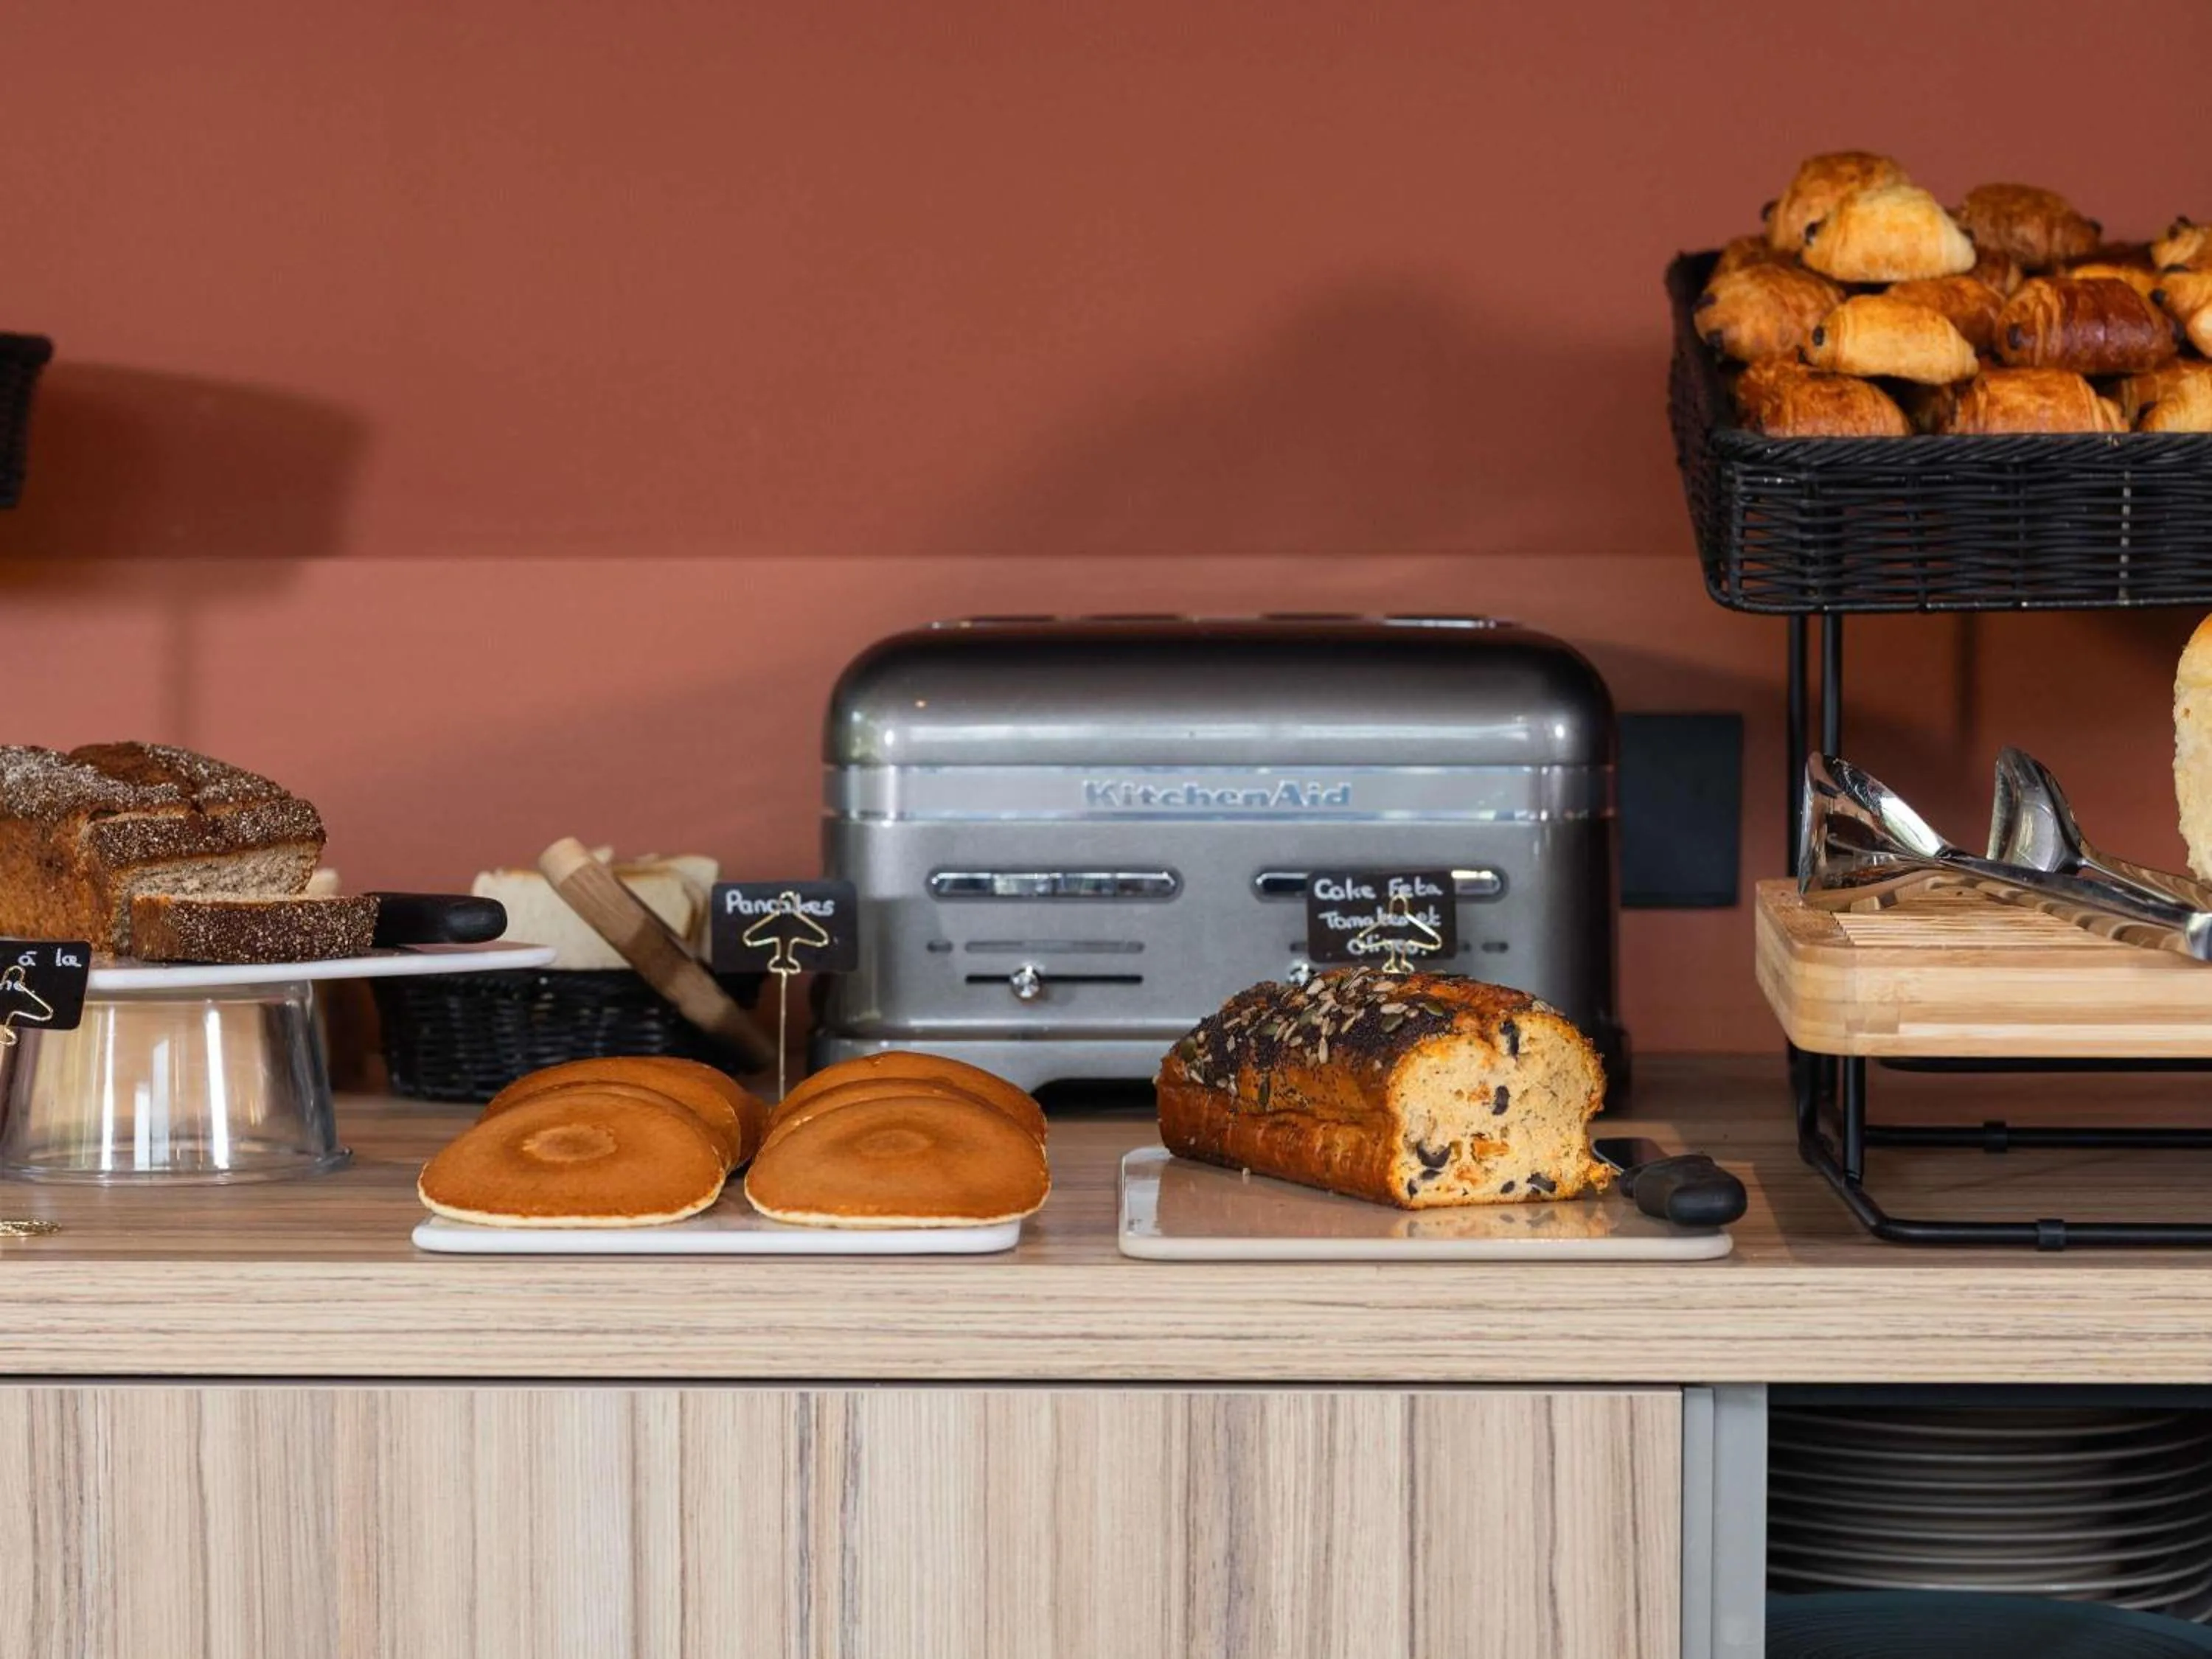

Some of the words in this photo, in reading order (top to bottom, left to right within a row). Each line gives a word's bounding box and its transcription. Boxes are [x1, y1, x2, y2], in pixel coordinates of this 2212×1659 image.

[1082, 779, 1352, 808] KitchenAid
[1313, 877, 1377, 900] Cake
[1388, 875, 1443, 899] Feta
[725, 889, 835, 916] Pancakes
[55, 947, 83, 967] la
